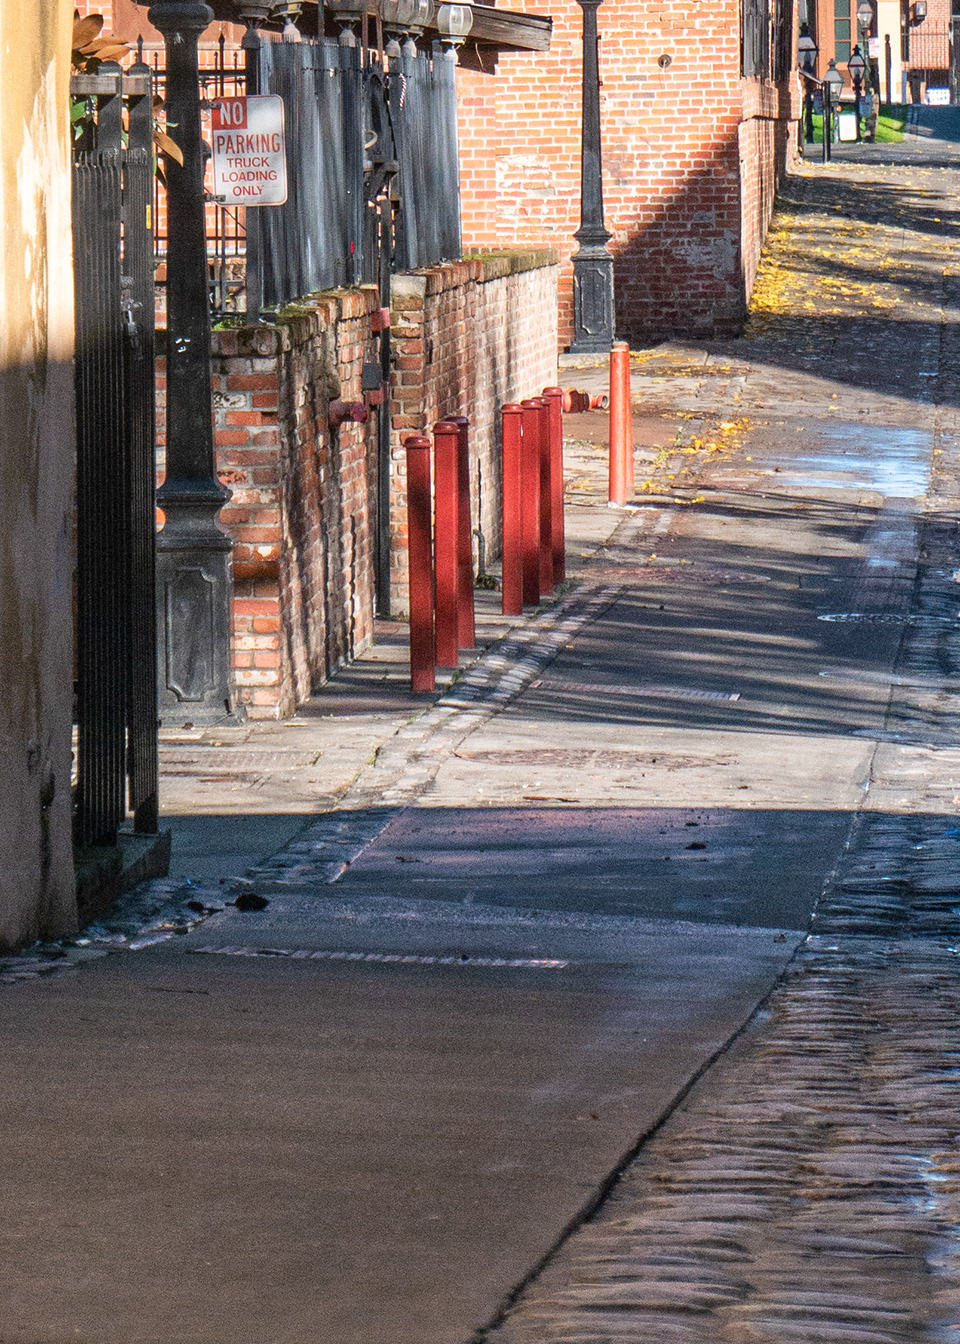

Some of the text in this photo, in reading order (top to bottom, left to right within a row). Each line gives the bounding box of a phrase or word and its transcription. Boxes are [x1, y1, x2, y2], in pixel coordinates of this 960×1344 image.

[220, 101, 244, 125] NO
[216, 133, 281, 154] PARKING
[226, 157, 270, 168] TRUCK
[221, 170, 278, 182] LOADING
[232, 185, 265, 197] ONLY
